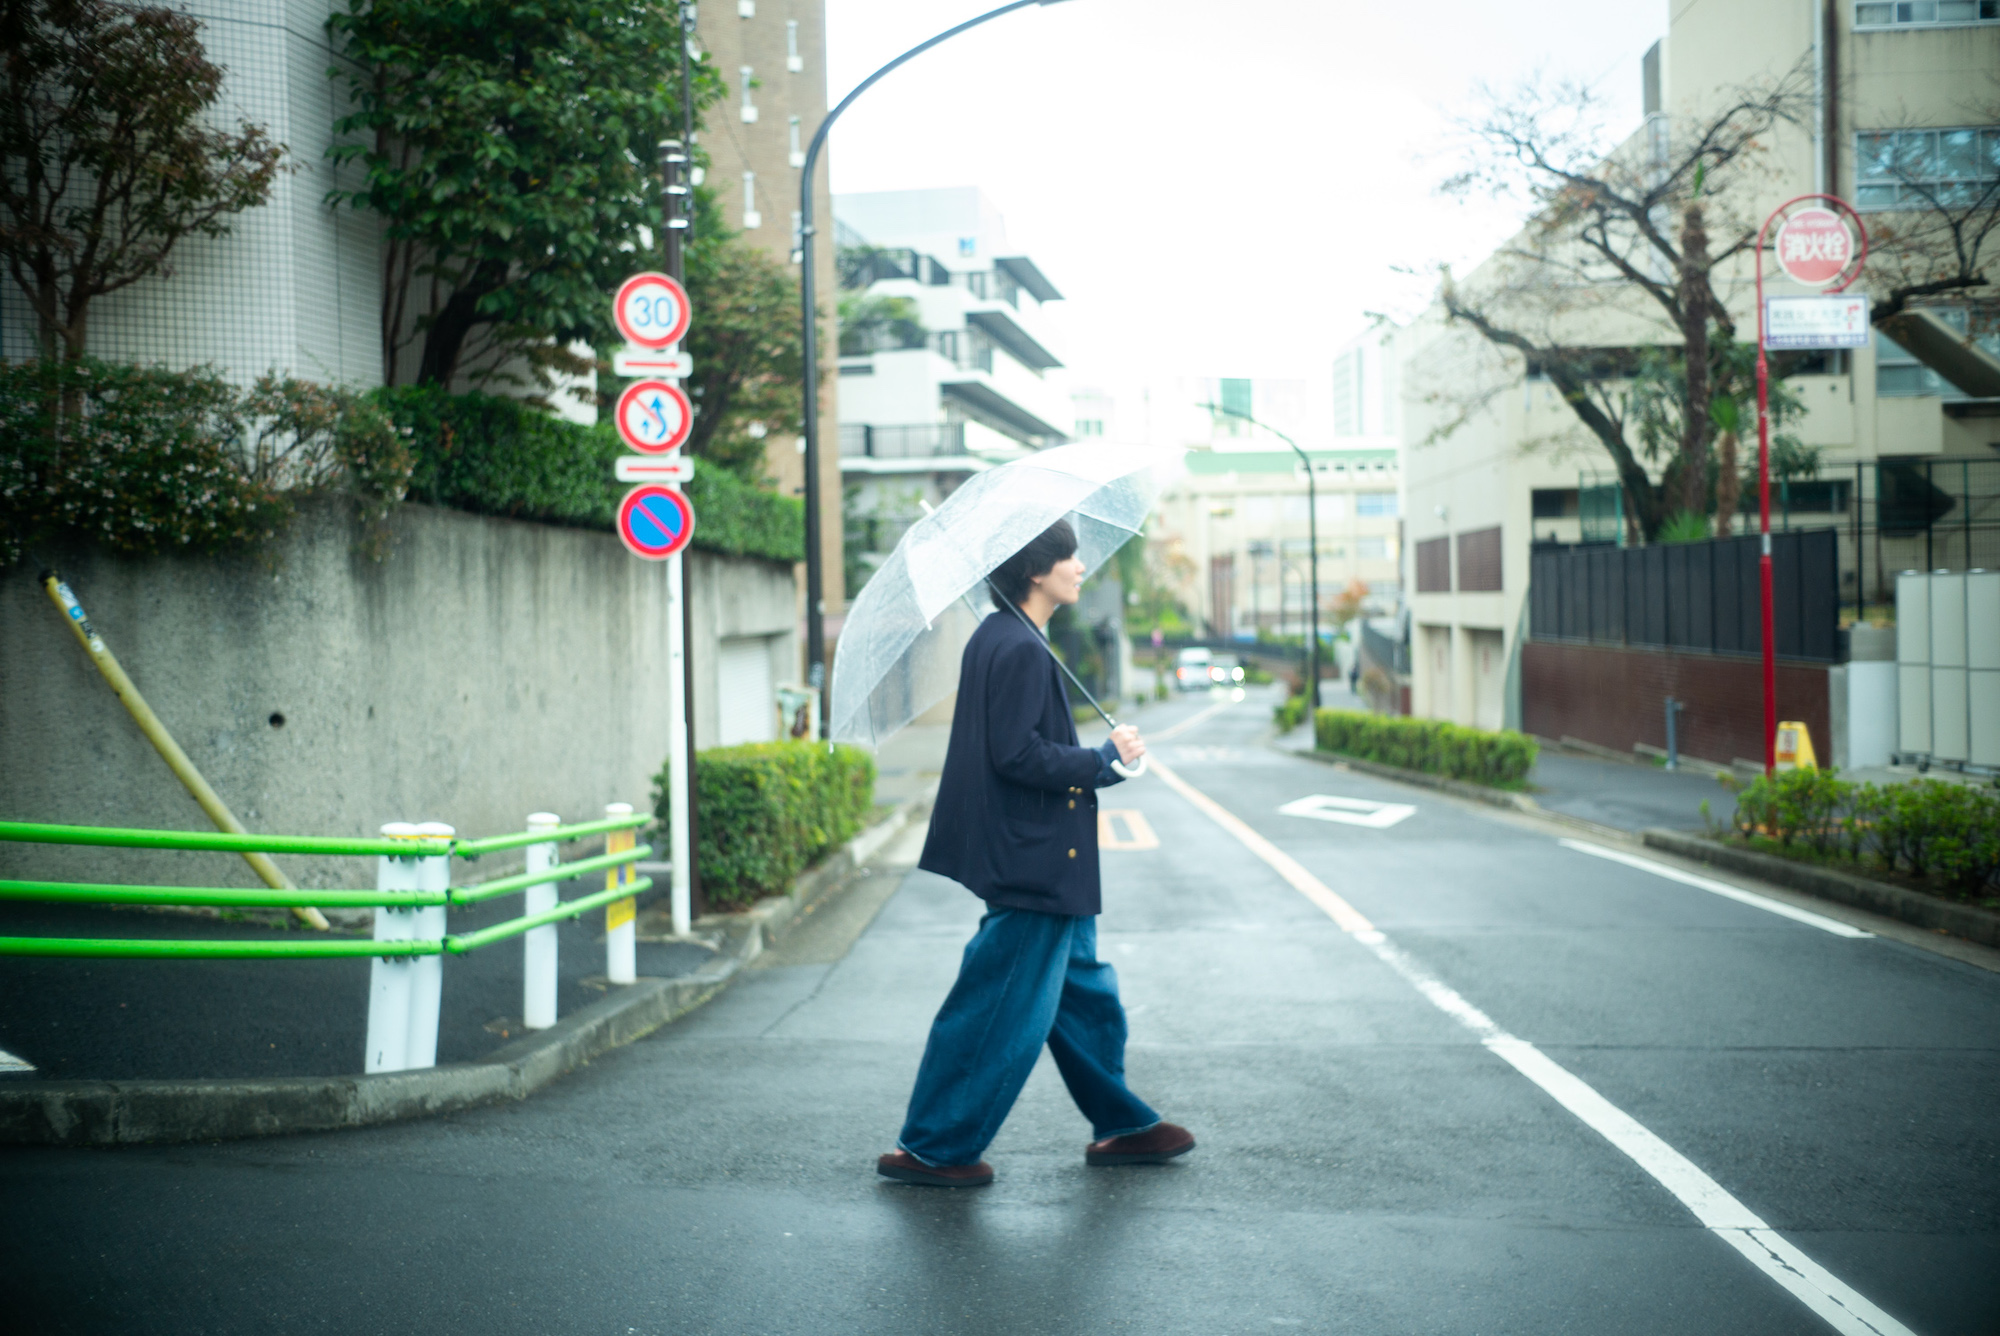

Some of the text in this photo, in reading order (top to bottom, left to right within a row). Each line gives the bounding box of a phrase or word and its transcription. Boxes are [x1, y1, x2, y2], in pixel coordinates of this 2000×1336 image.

[1784, 232, 1845, 261] 消火栓
[634, 296, 673, 328] 30
